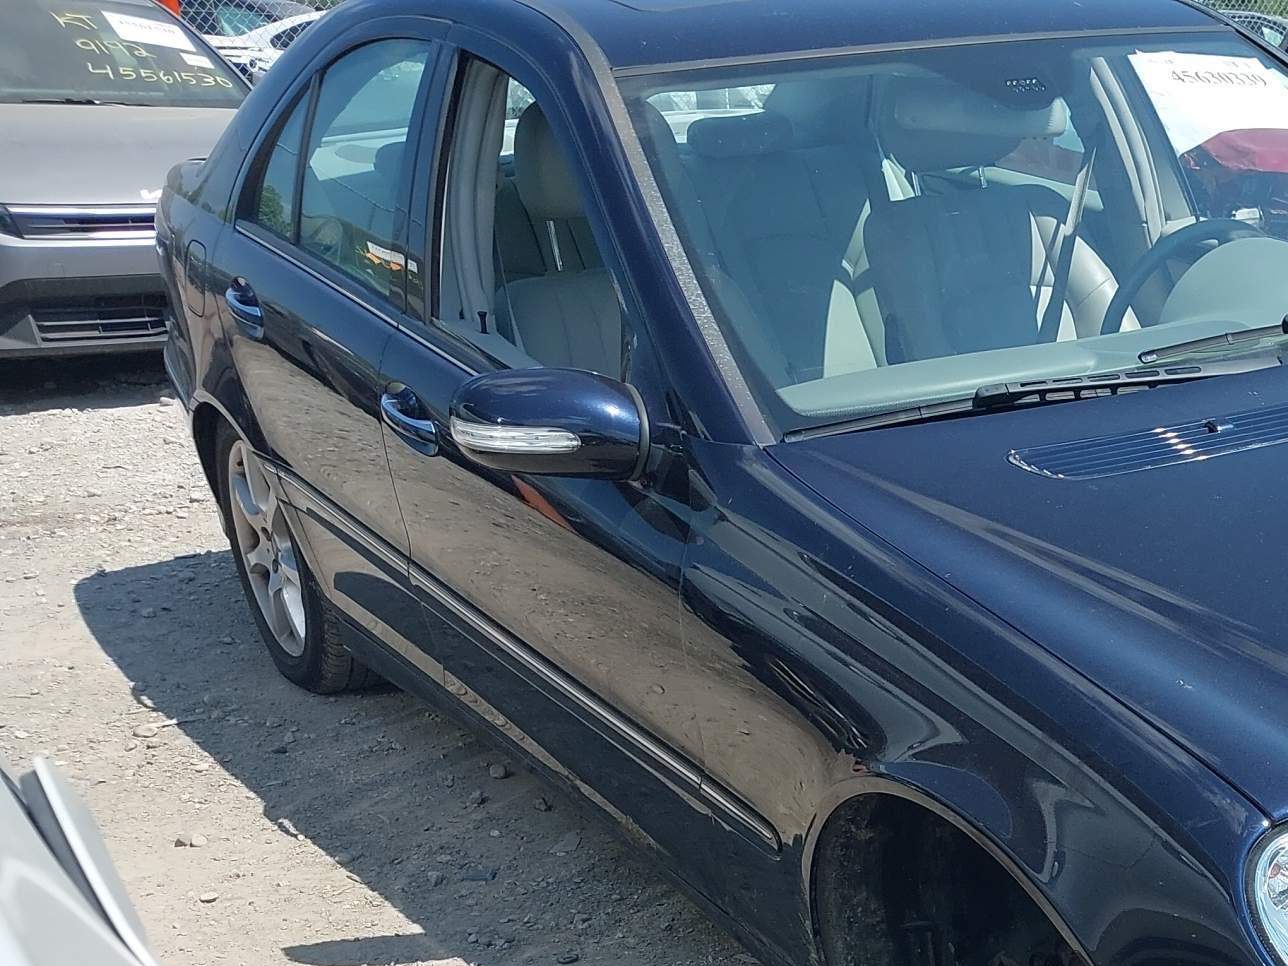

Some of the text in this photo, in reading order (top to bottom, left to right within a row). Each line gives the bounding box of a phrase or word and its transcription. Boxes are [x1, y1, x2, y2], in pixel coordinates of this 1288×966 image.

[74, 38, 157, 59] 9192
[86, 62, 233, 89] 45561530
[1170, 69, 1268, 87] 45630339
